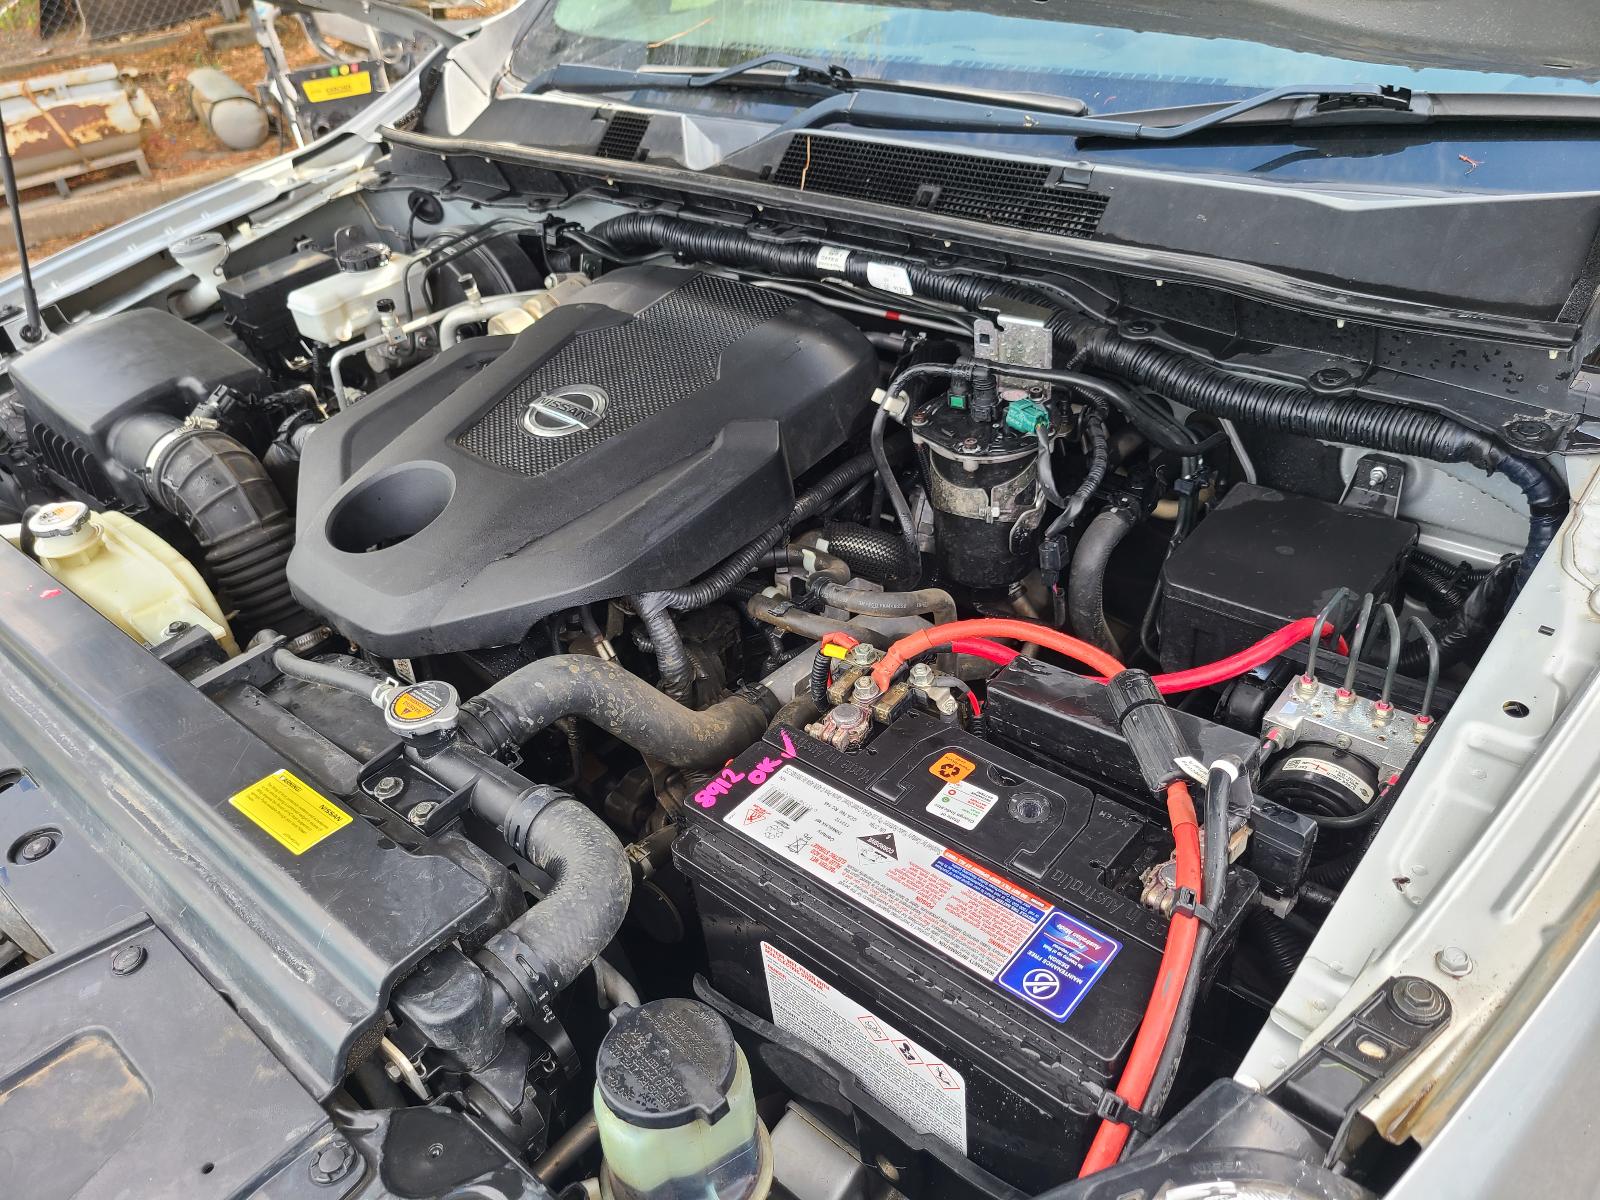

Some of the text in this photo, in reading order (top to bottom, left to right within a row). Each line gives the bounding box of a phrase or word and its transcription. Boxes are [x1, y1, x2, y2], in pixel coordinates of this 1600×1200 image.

[537, 396, 588, 420] NISSAN
[694, 768, 745, 808] 8912
[747, 756, 783, 784] OK
[319, 803, 344, 823] NISSAN
[802, 832, 813, 840] Pb
[863, 839, 892, 857] CORROSIVE
[1047, 866, 1124, 917] Australia
[914, 895, 934, 909] POISON
[1123, 908, 1139, 926] in
[1055, 922, 1101, 950] Australian Made
[1062, 934, 1086, 949] Proudly
[986, 937, 1013, 954] WARNING
[1026, 949, 1042, 961] FREE
[1047, 954, 1070, 969] DESIGN
[1041, 958, 1083, 984] MAINTENANCE
